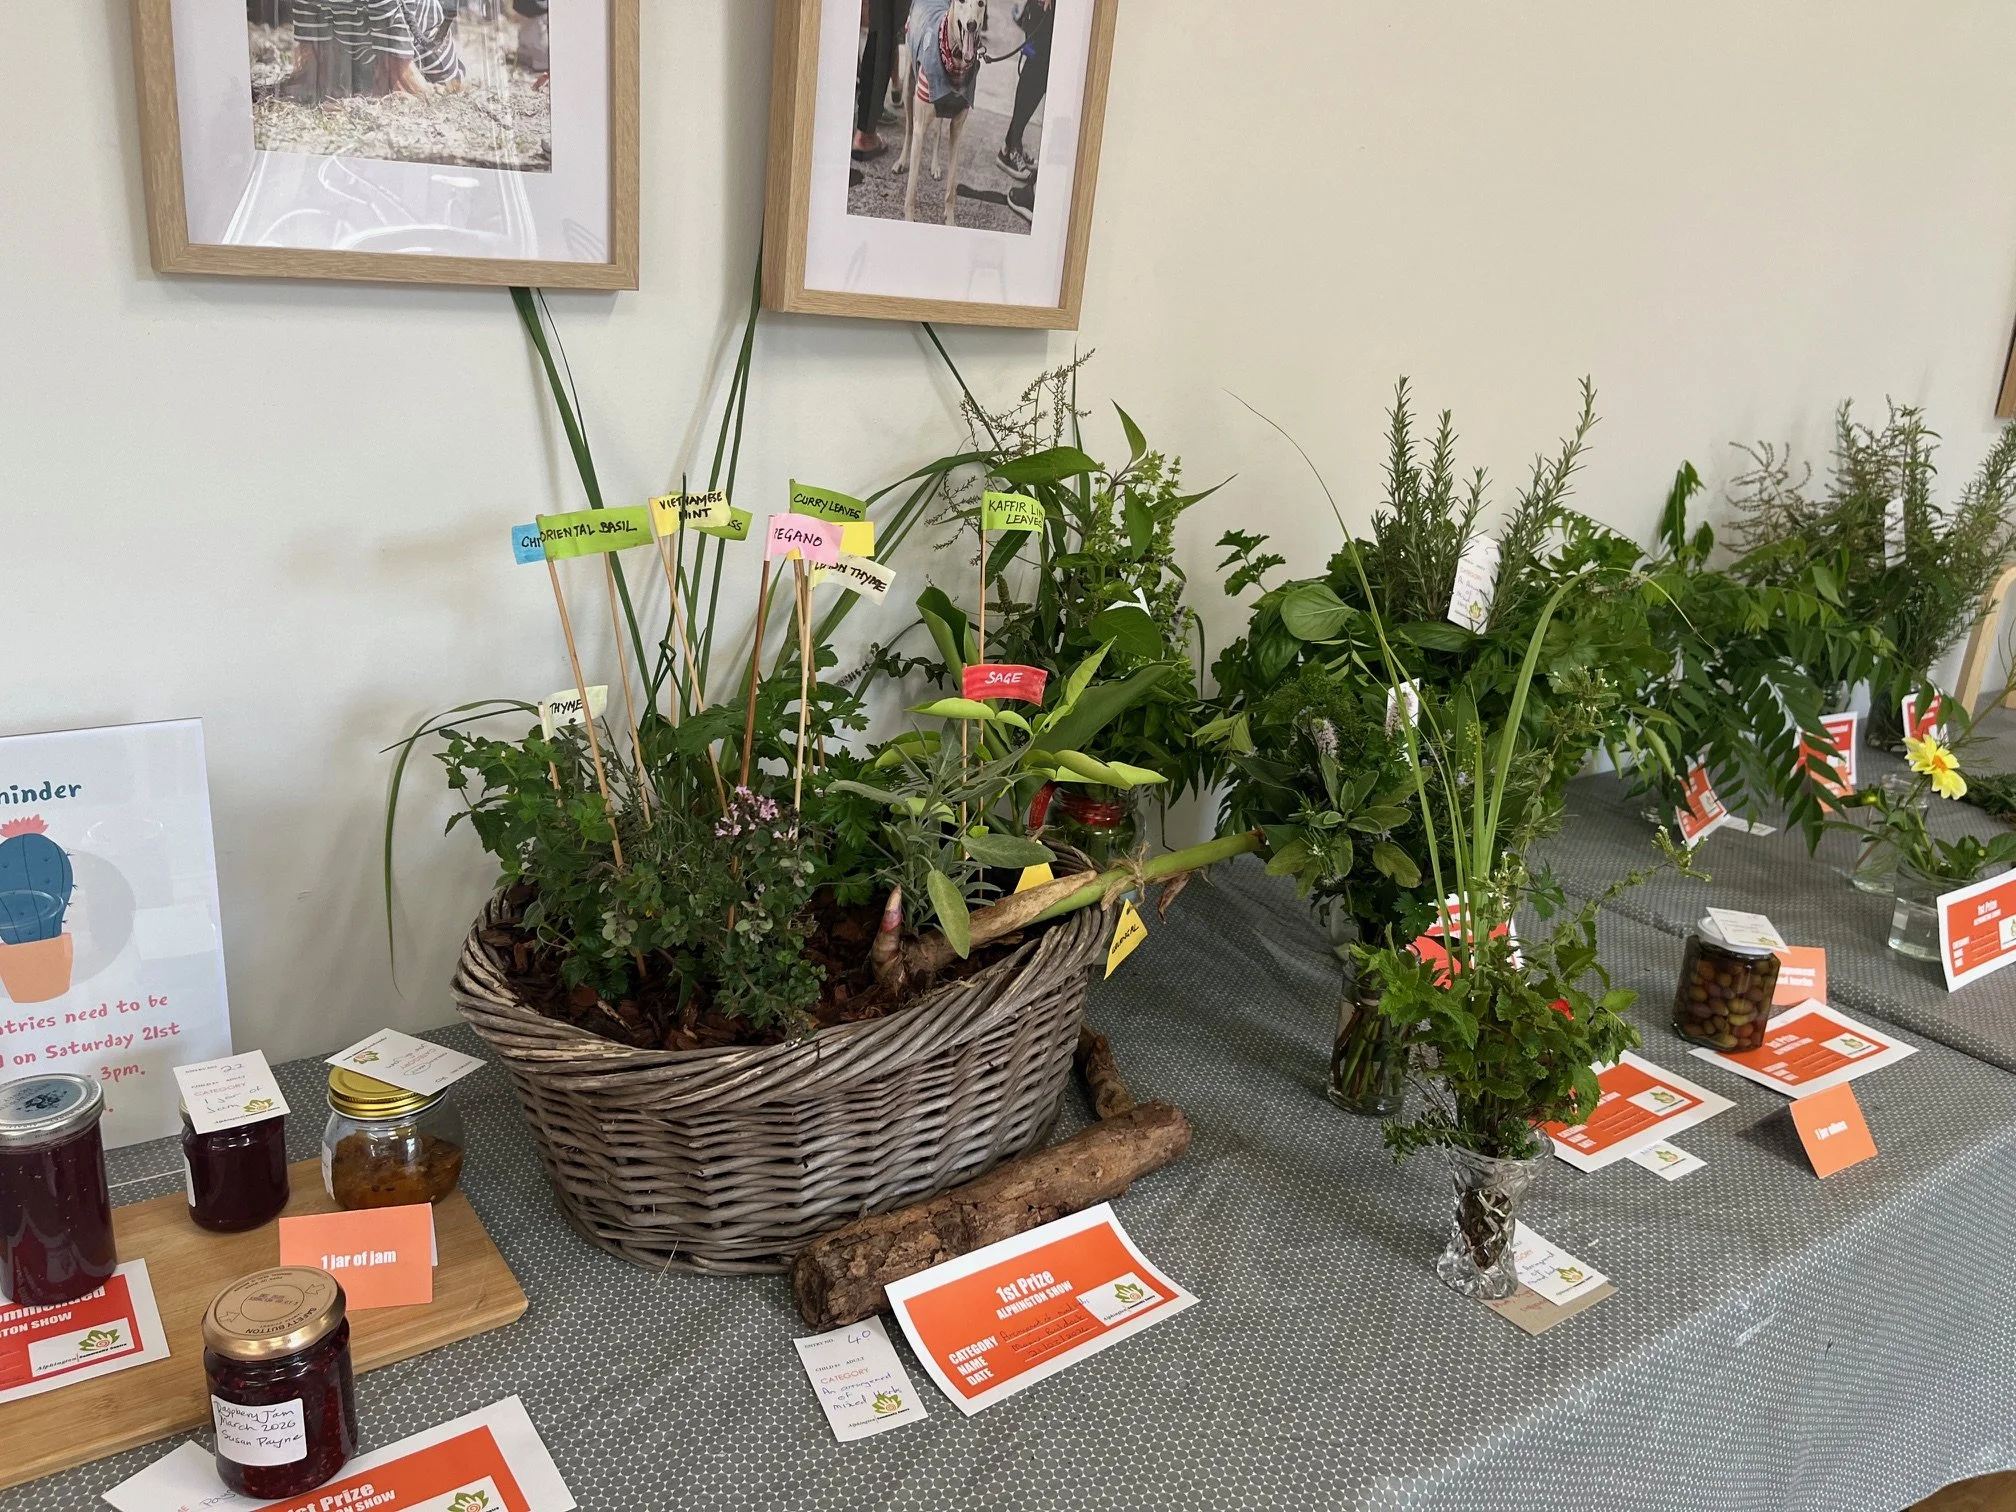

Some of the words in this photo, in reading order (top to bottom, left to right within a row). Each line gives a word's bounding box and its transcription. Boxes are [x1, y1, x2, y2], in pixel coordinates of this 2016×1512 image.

[793, 493, 827, 514] CURRY
[828, 501, 862, 520] LEAVES
[988, 499, 1027, 513] KAFFIR
[539, 523, 596, 543] ORIENTAL
[598, 519, 638, 534] BASIL
[1005, 513, 1043, 528] LEAVES
[850, 566, 888, 593] THYME
[984, 670, 1024, 685] SAGE
[549, 698, 584, 715] THYME
[0, 1016, 57, 1037] tries
[64, 1003, 108, 1025] need
[116, 999, 140, 1014] to
[148, 994, 168, 1009] be
[13, 1052, 37, 1067] on
[44, 1033, 134, 1060] Saturday
[142, 1021, 181, 1042] 21st
[100, 1063, 147, 1083] 3pm.
[321, 1255, 328, 1270] 1
[330, 1254, 351, 1270] jar
[353, 1251, 367, 1267] of
[369, 1249, 397, 1267] jam
[995, 1282, 1021, 1304] 1st
[1016, 1270, 1055, 1295] Prize
[995, 1291, 1049, 1321] ALPHINGTON
[1045, 1280, 1074, 1300] SHOW
[0, 1323, 29, 1338] TON
[31, 1311, 73, 1330] SHOW
[287, 1306, 318, 1329] SAFETY
[245, 1323, 288, 1335] BUTTON
[848, 1330, 871, 1344] 40
[947, 1335, 999, 1365] CATEGORY
[35, 1357, 77, 1372] Alphington
[956, 1355, 988, 1377] NAME
[820, 1367, 870, 1384] CATEGORY
[965, 1367, 995, 1387] DATE
[219, 1414, 257, 1431] March
[261, 1407, 295, 1424] Jam
[221, 1429, 252, 1446] Susan
[256, 1433, 304, 1448] Payne
[319, 1482, 375, 1512] Prize
[356, 1489, 396, 1512] SHOW
